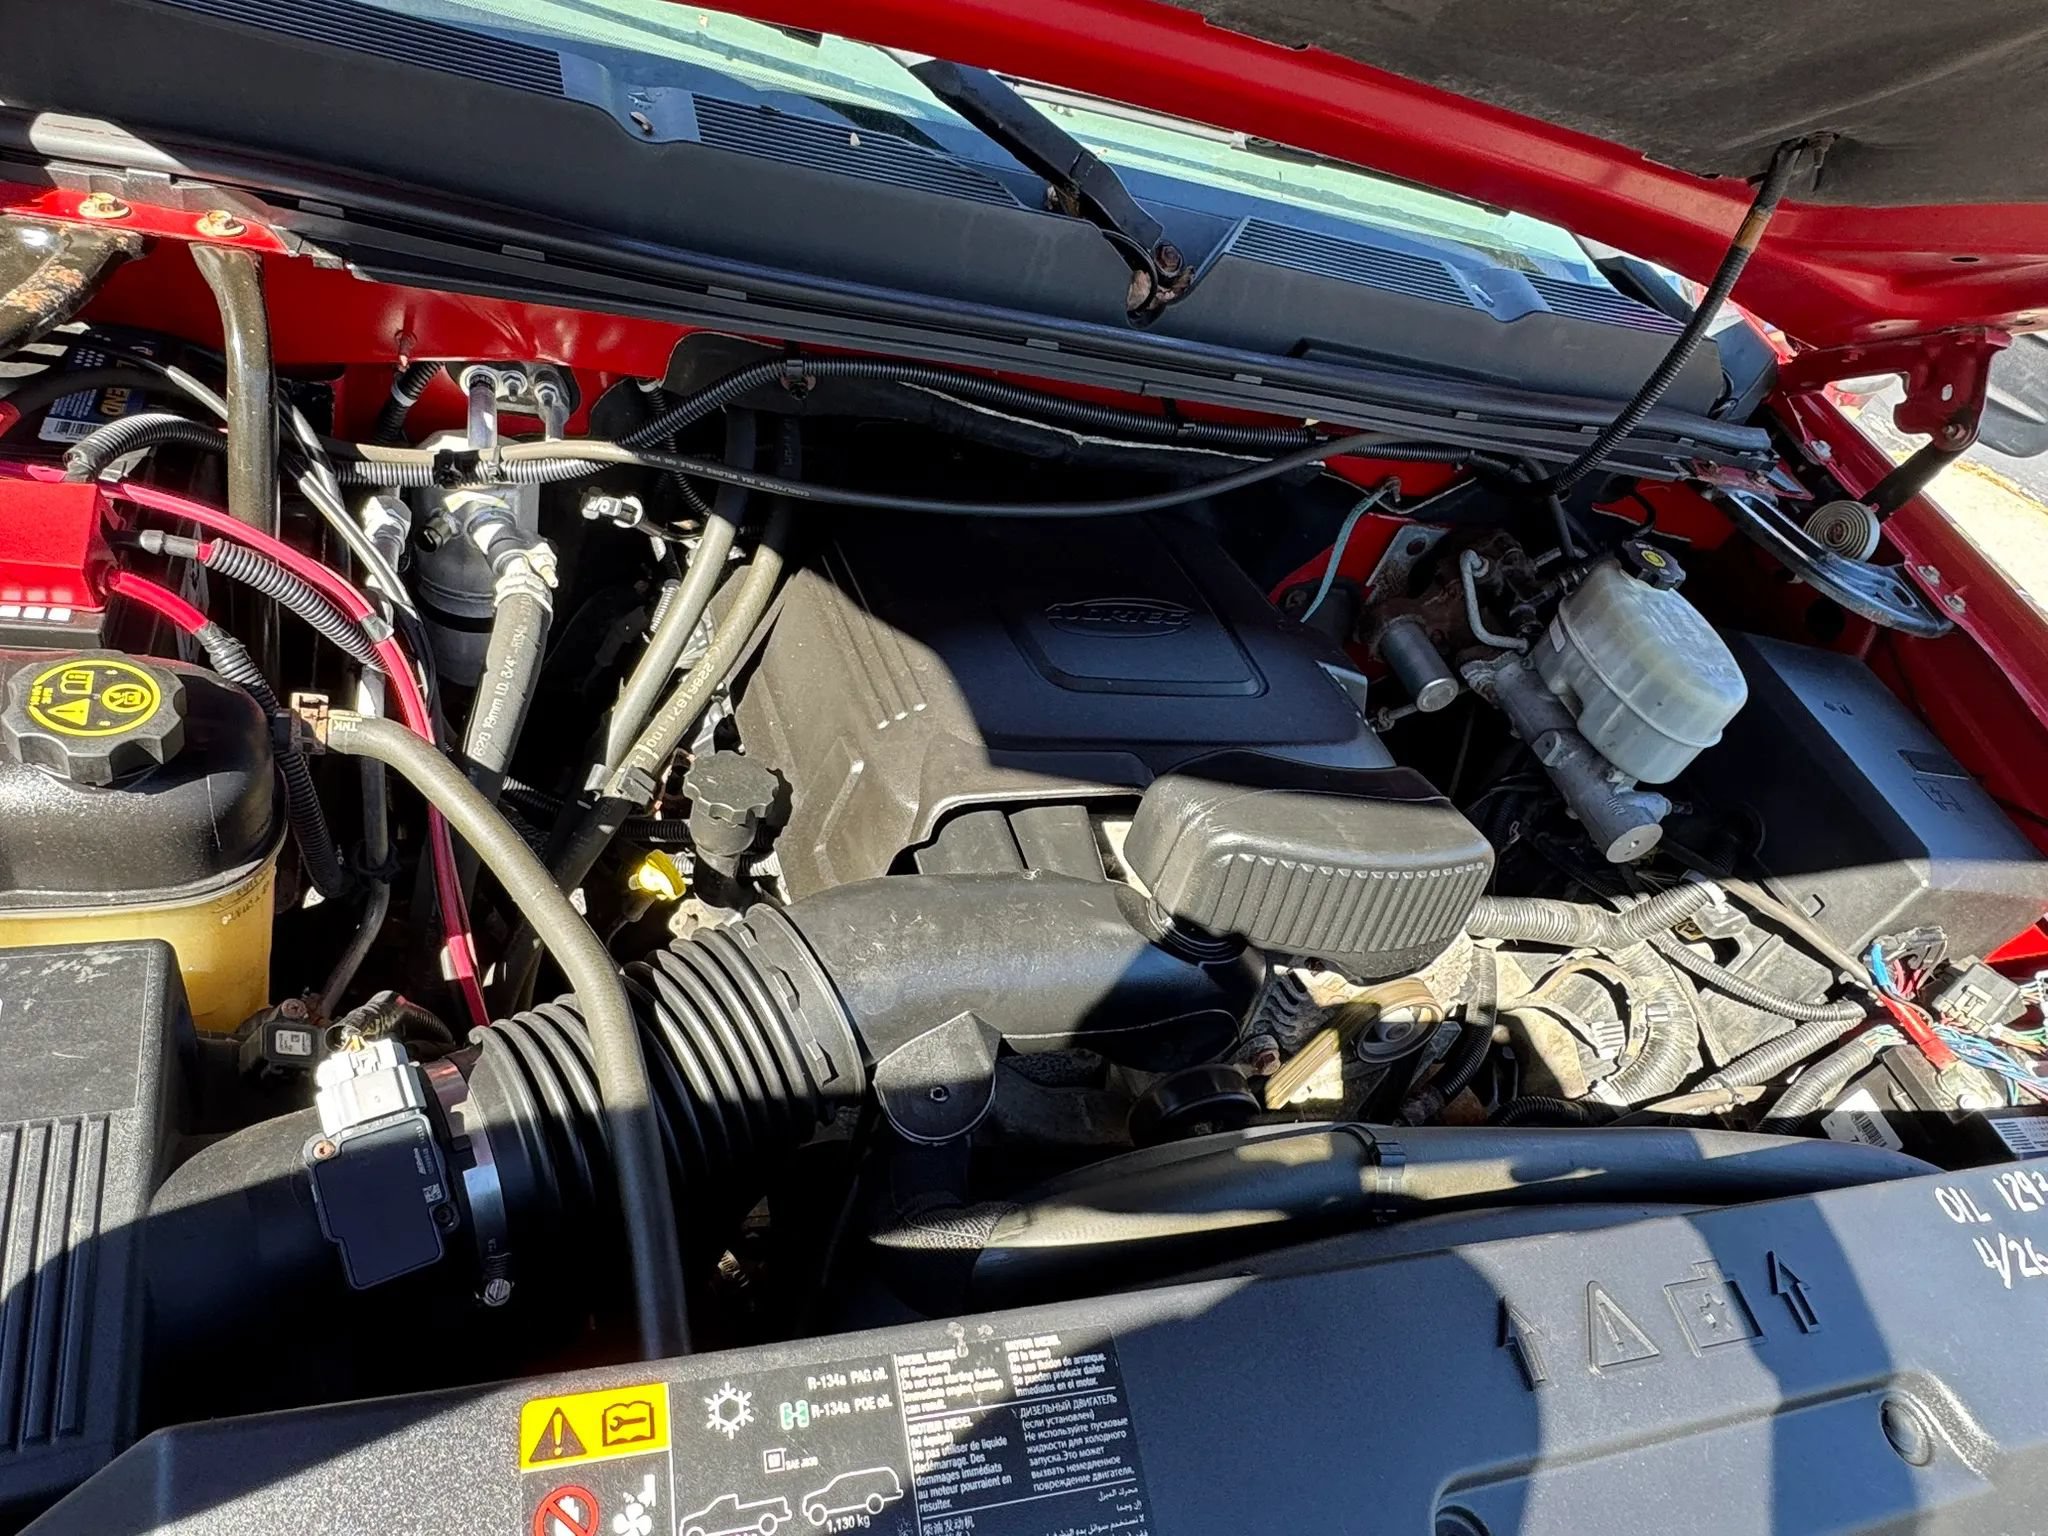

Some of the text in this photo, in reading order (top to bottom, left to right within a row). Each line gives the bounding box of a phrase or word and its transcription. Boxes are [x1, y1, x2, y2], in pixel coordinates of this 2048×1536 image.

[483, 698, 504, 729] 19mm
[1934, 1186, 1992, 1224] OIL
[1062, 1355, 1072, 1367] de
[1073, 1352, 1106, 1366] arranque.
[807, 1373, 847, 1390] R-134a
[850, 1369, 872, 1384] PAG
[1053, 1367, 1082, 1380] producir
[1057, 1382, 1067, 1391] en
[1067, 1379, 1075, 1390] el
[810, 1401, 851, 1419] R-134a
[854, 1396, 876, 1412] POE
[1020, 1394, 1117, 1419] ДИЗЕЛЬНЫЙ ДВИГАТЕЛЬ
[1022, 1408, 1095, 1431] (если установлен)
[1024, 1418, 1128, 1441] Не используйте пусковые
[925, 1447, 940, 1460] pas
[941, 1443, 968, 1457] utiliser
[969, 1440, 981, 1451] de
[981, 1436, 1008, 1450] liquide
[1027, 1430, 1127, 1454] жидкости для холодного
[1079, 1446, 1105, 1458] может
[970, 1453, 985, 1464] Des
[1031, 1456, 1121, 1479] вызвать немедленное
[916, 1463, 1003, 1486] dommages immédiats
[1033, 1466, 1135, 1492] повреждение двигателя.
[918, 1474, 1012, 1500] au moteur pourraient en
[826, 1514, 871, 1535] 1,130 kg
